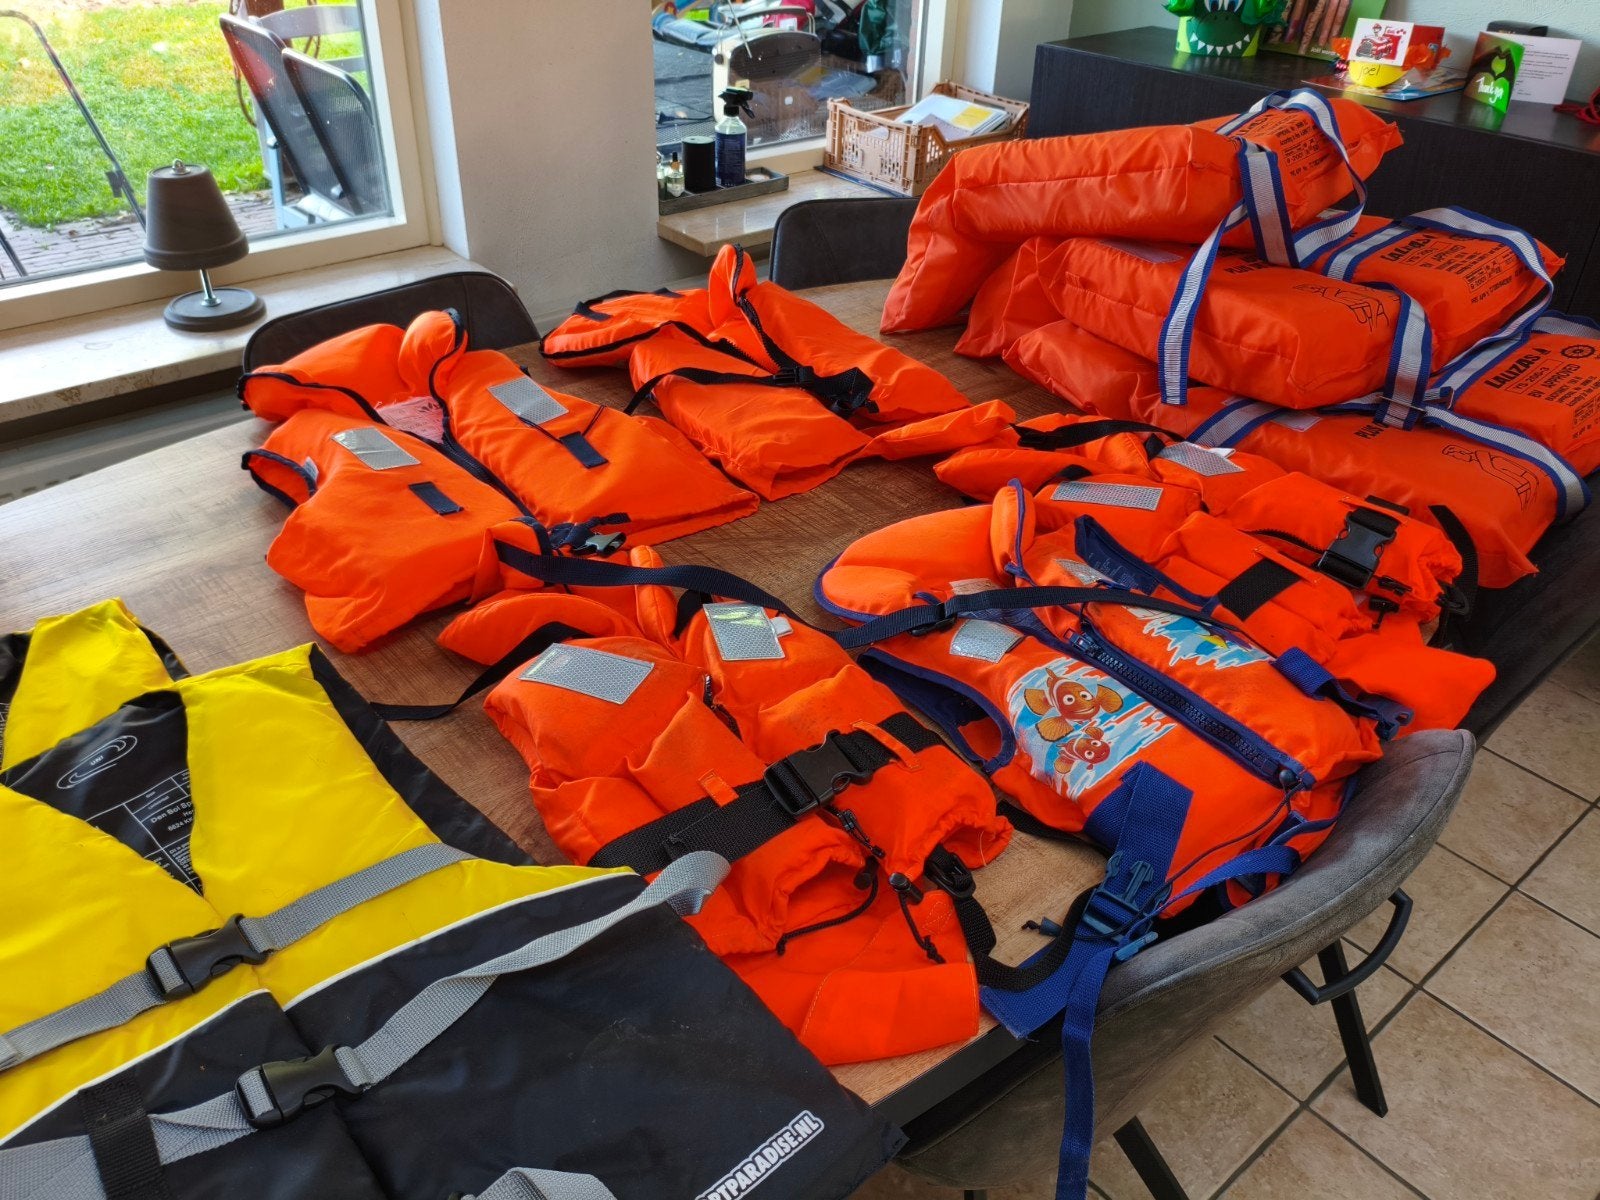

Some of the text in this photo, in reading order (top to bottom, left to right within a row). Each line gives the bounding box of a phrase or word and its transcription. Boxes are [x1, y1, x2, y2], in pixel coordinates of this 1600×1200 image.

[1484, 354, 1541, 390] LALIZAS
[150, 812, 168, 824] Den
[703, 1115, 820, 1200] RTPARADISE.NL
